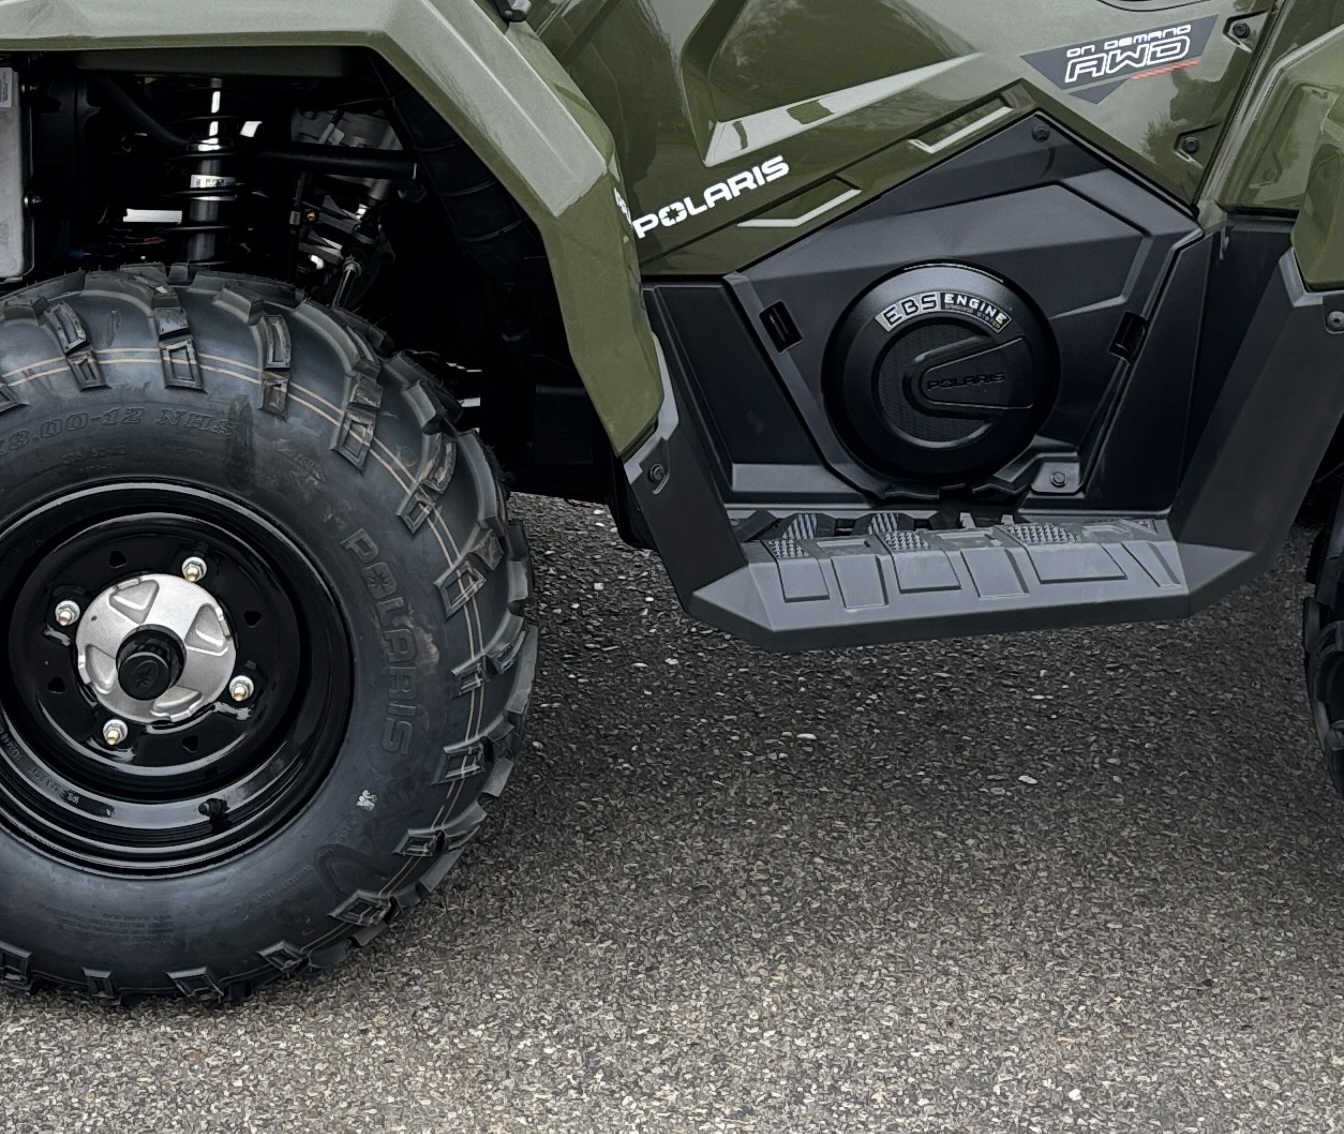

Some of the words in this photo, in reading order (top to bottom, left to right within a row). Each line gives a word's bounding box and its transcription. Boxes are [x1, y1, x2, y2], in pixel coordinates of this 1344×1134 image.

[1064, 35, 1191, 84] AWD
[1066, 44, 1096, 58] ON
[1103, 24, 1192, 50] DEMAND
[631, 153, 790, 239] POLARIS
[883, 293, 938, 327] EBS
[943, 292, 1008, 325] ENGINE
[926, 371, 1006, 392] POLARIS
[340, 526, 420, 755] POLARIS
